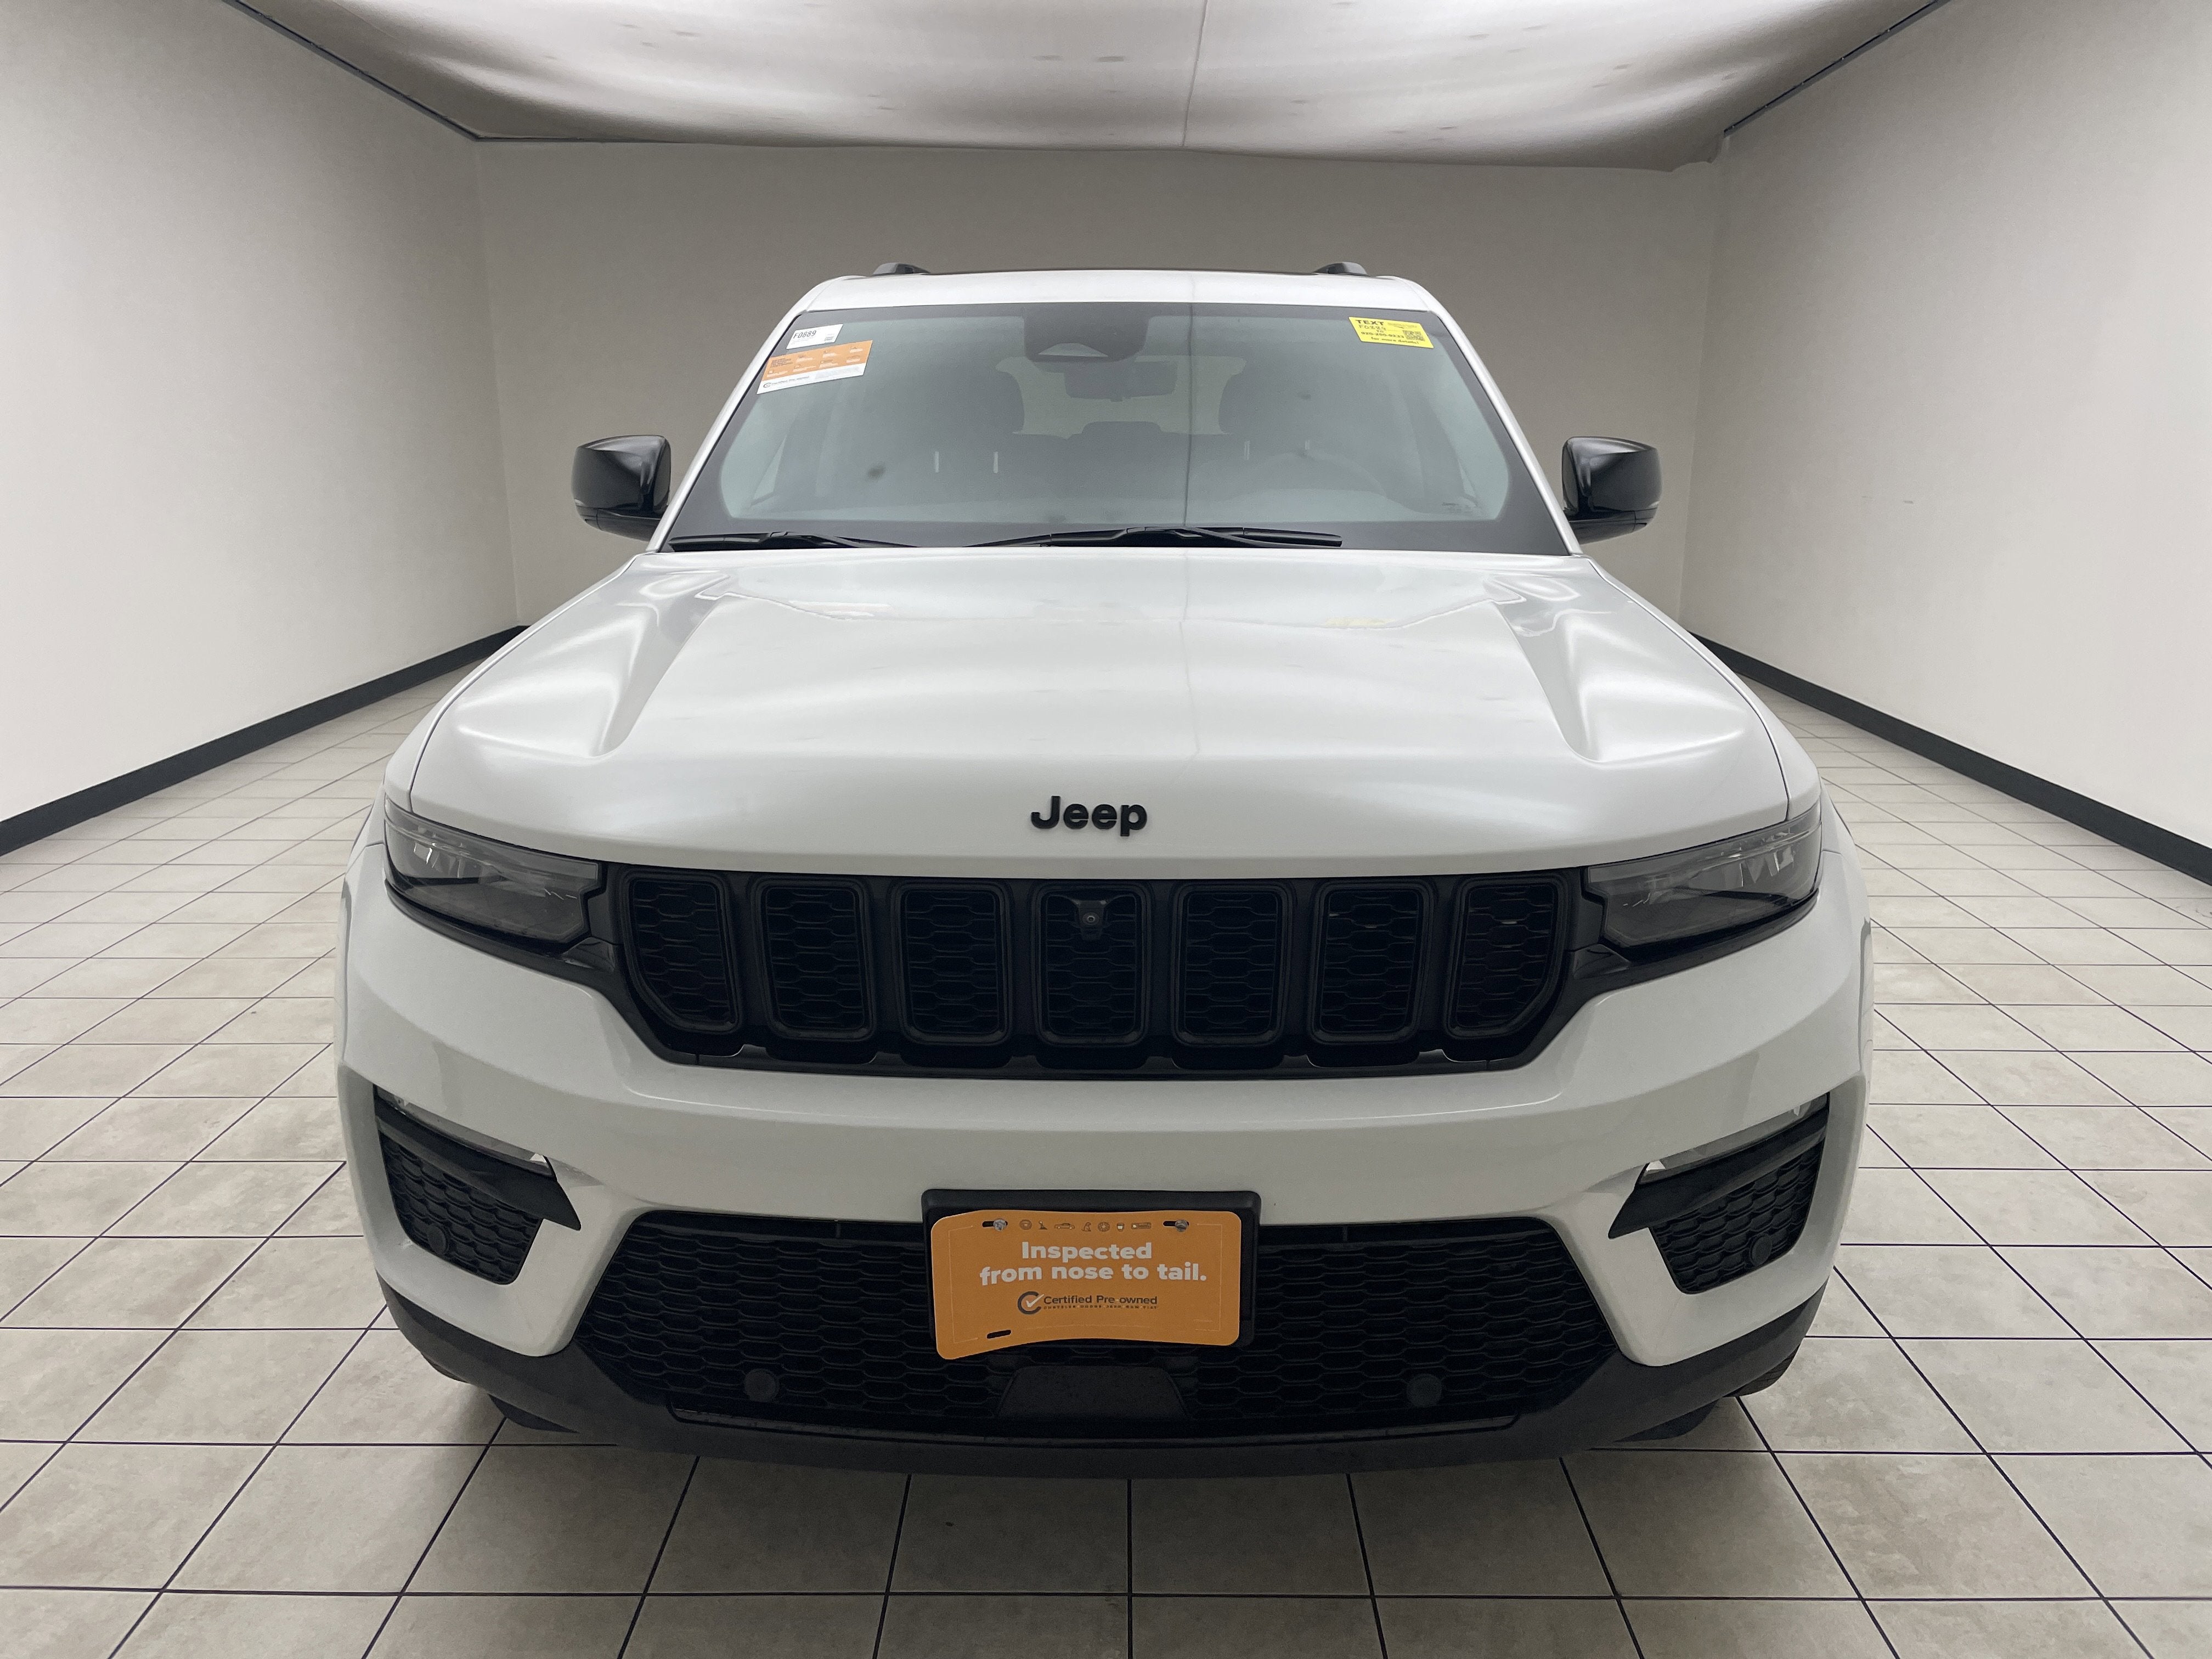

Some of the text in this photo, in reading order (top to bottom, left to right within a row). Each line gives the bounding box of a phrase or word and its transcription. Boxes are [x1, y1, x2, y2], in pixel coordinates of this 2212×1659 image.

[793, 330, 817, 339] F0889
[1031, 795, 1147, 836] Jeep
[1022, 1242, 1152, 1262] Inspected
[980, 1262, 1207, 1285] from nose to tail.
[1044, 1295, 1092, 1305] Certified
